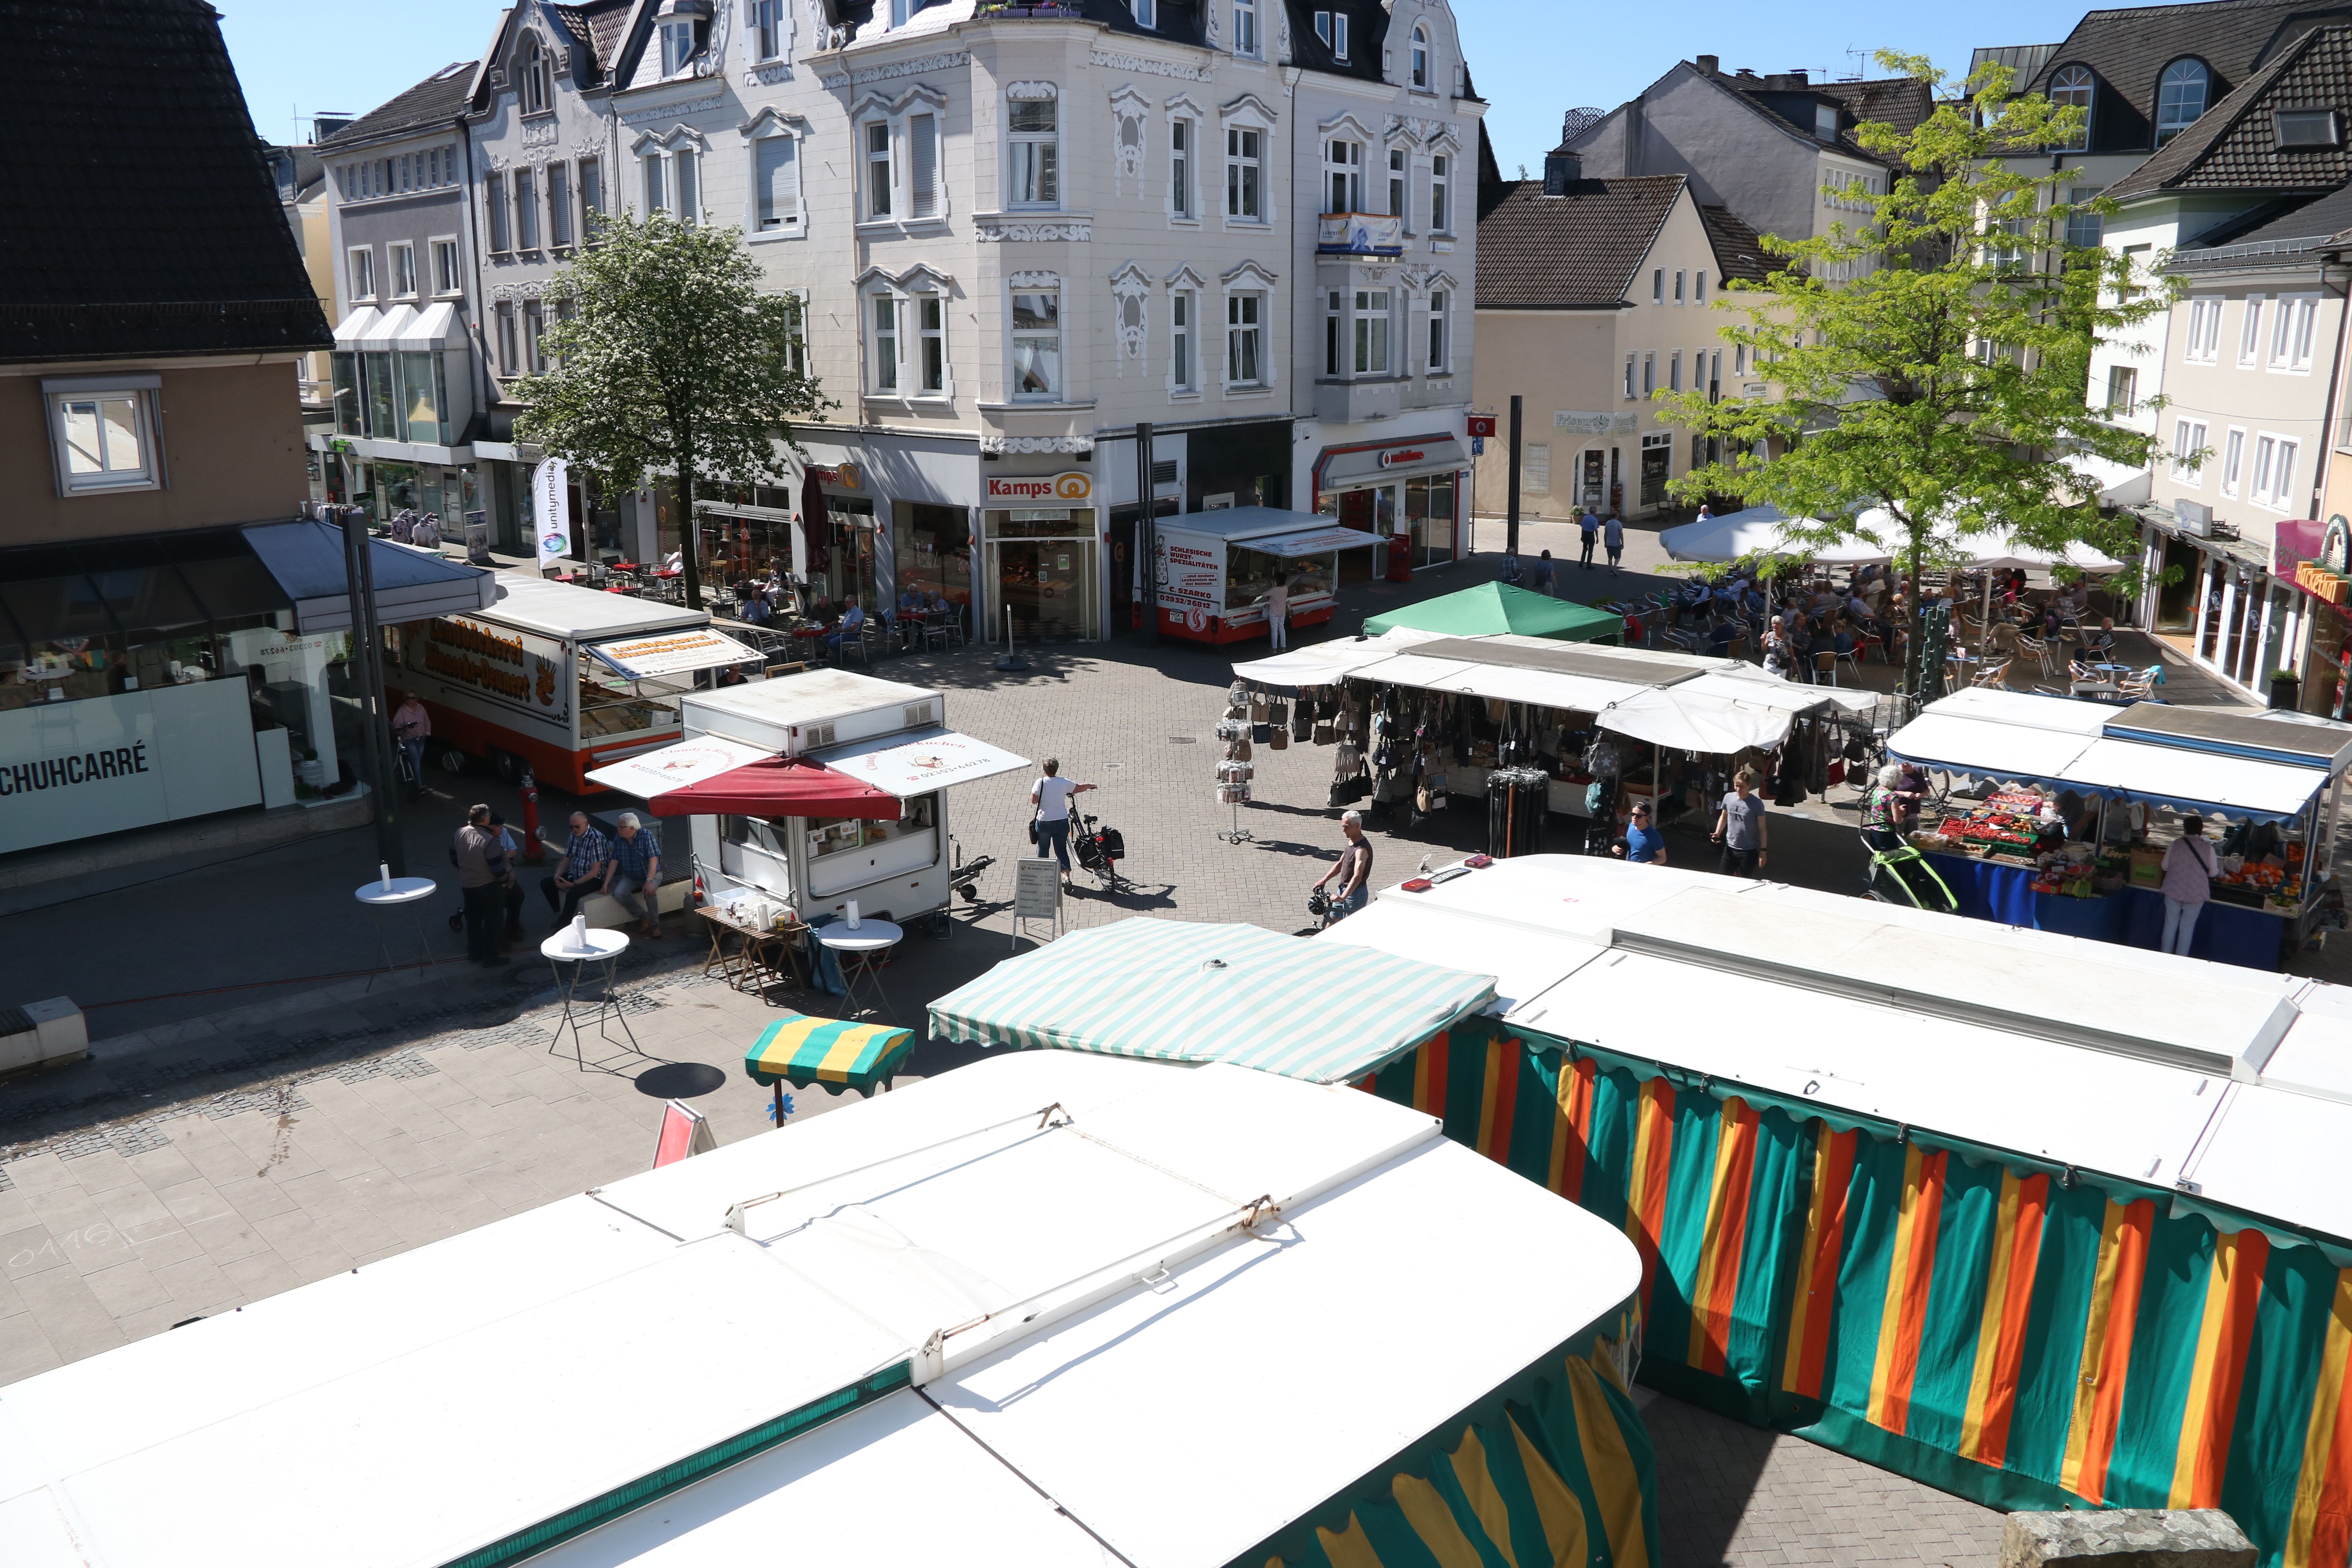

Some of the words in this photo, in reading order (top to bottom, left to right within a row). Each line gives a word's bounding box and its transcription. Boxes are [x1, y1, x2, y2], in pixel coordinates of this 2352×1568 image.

[1556, 414, 1593, 426] Friseur
[804, 466, 838, 485] mps
[545, 464, 559, 529] unitymedia
[989, 480, 1051, 498] Kamps
[1170, 546, 1212, 557] SCHLESISCHE
[1170, 558, 1218, 570] SPEZIALITÄTEN
[1160, 595, 1210, 608] 02932/26812
[1178, 588, 1211, 599] SZARKO
[430, 617, 524, 667] Landbäckerei
[608, 635, 711, 653] Landbäckerei
[0, 739, 149, 796] CHUHCARRÉ
